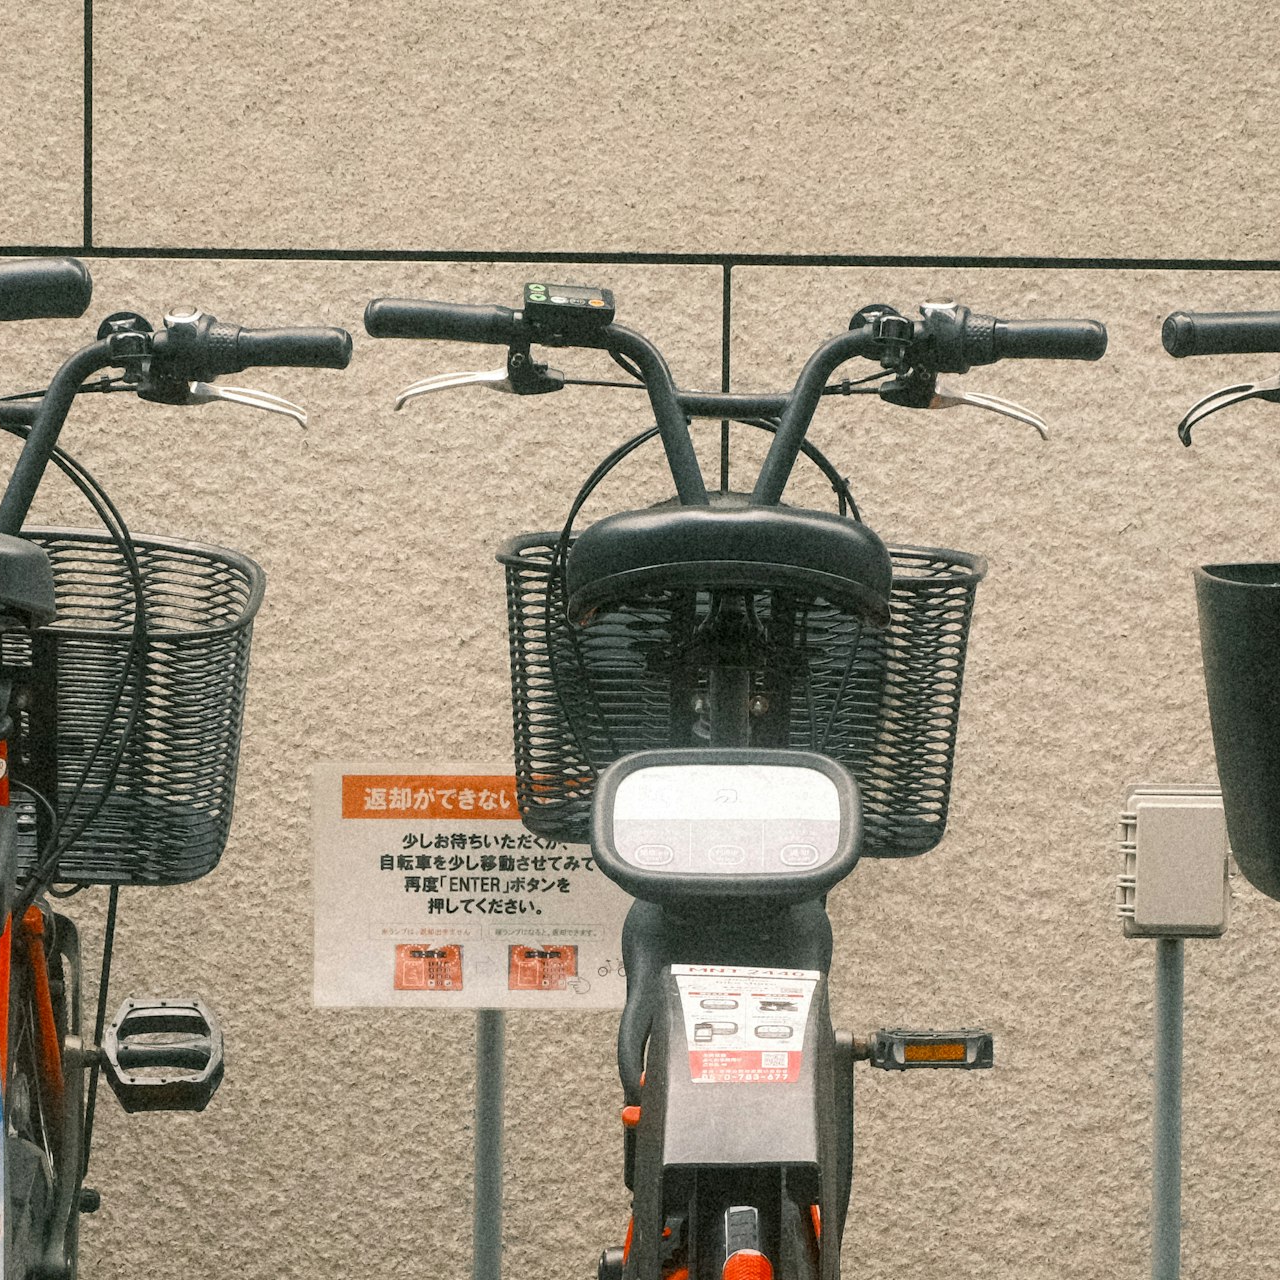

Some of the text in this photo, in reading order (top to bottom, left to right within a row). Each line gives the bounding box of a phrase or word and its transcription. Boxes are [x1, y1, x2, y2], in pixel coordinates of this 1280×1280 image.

[380, 854, 594, 872] 自転車を少し移動させてみて
[404, 876, 570, 894] 再度「ENTER」ボタンを
[428, 898, 543, 916] 押してください。
